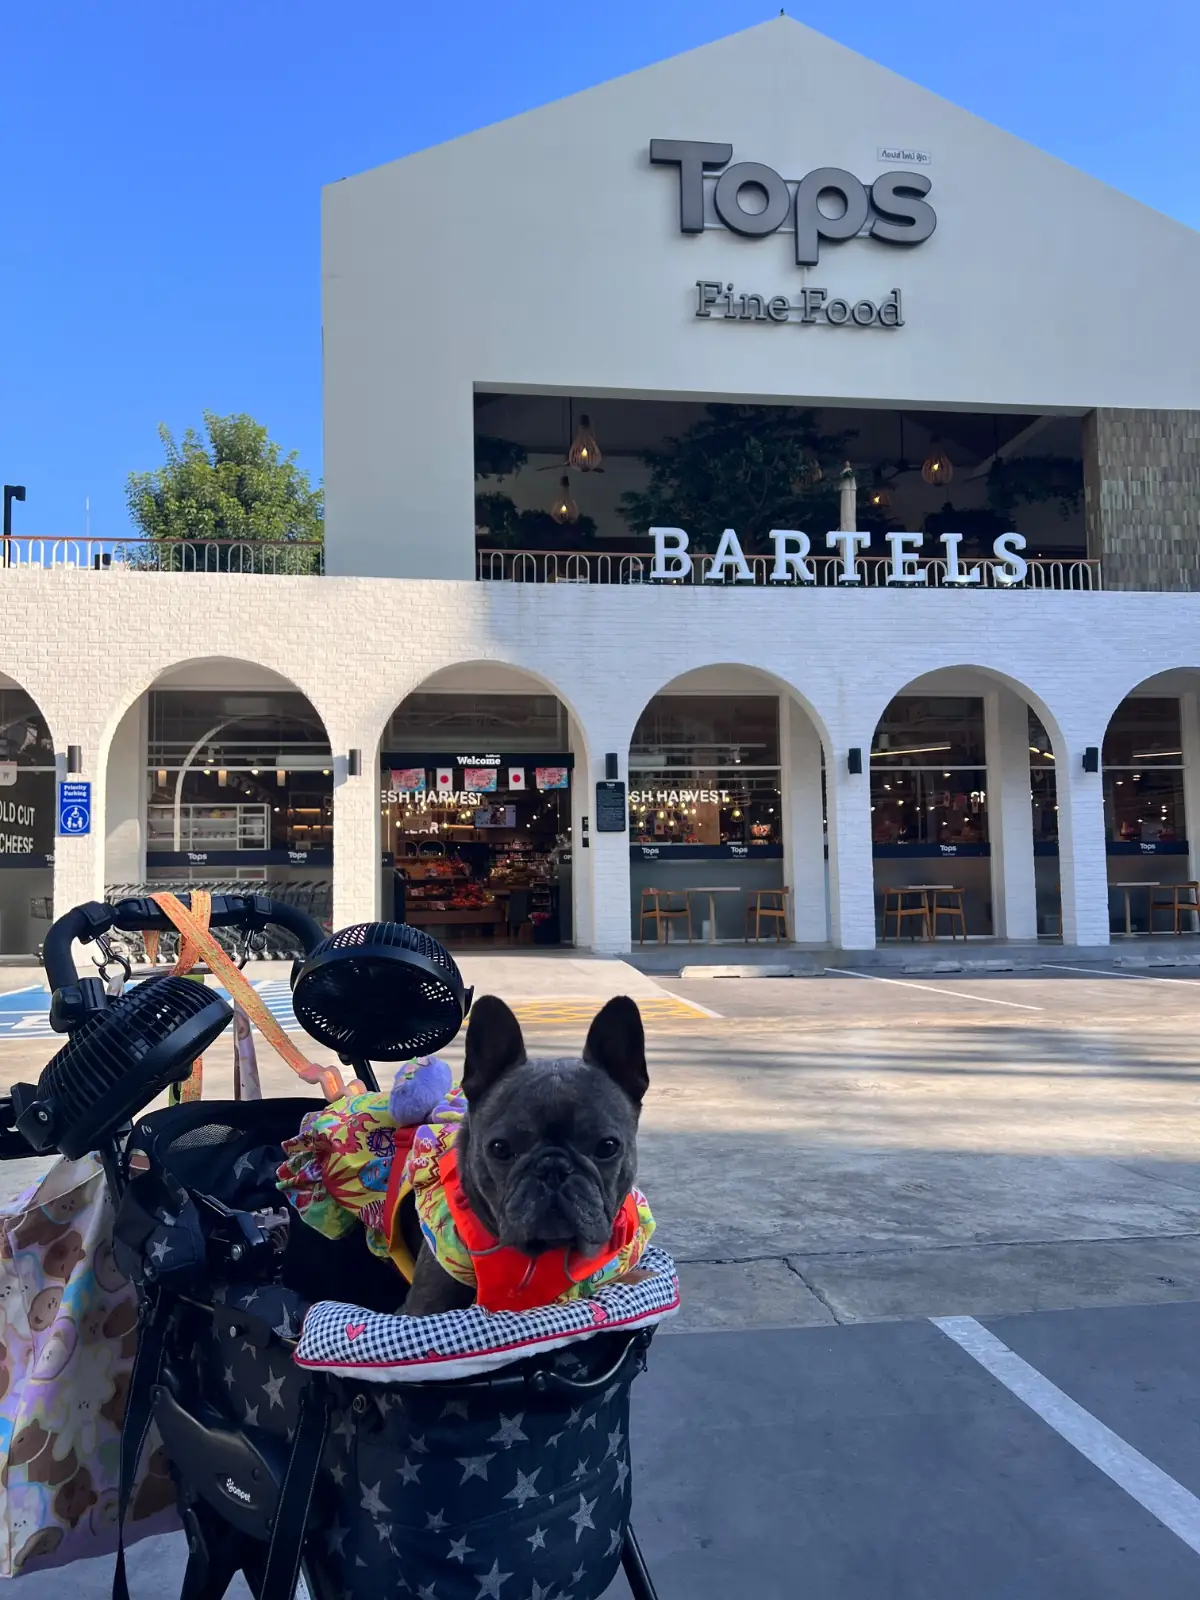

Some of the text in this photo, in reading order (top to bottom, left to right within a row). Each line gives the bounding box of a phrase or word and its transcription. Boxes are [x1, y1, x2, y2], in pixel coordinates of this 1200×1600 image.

[650, 138, 937, 266] Tops
[695, 280, 905, 327] Fine Food
[648, 527, 1028, 583] BARTELS
[457, 756, 501, 765] Welcome
[415, 790, 483, 805] HARVEST
[628, 790, 729, 803] SH HARVEST
[18, 805, 35, 827] CUT
[642, 847, 659, 856] Tops
[731, 846, 748, 855] Tops
[940, 845, 957, 853] Tops
[187, 853, 207, 861] Tops
[288, 851, 307, 860] Tops
